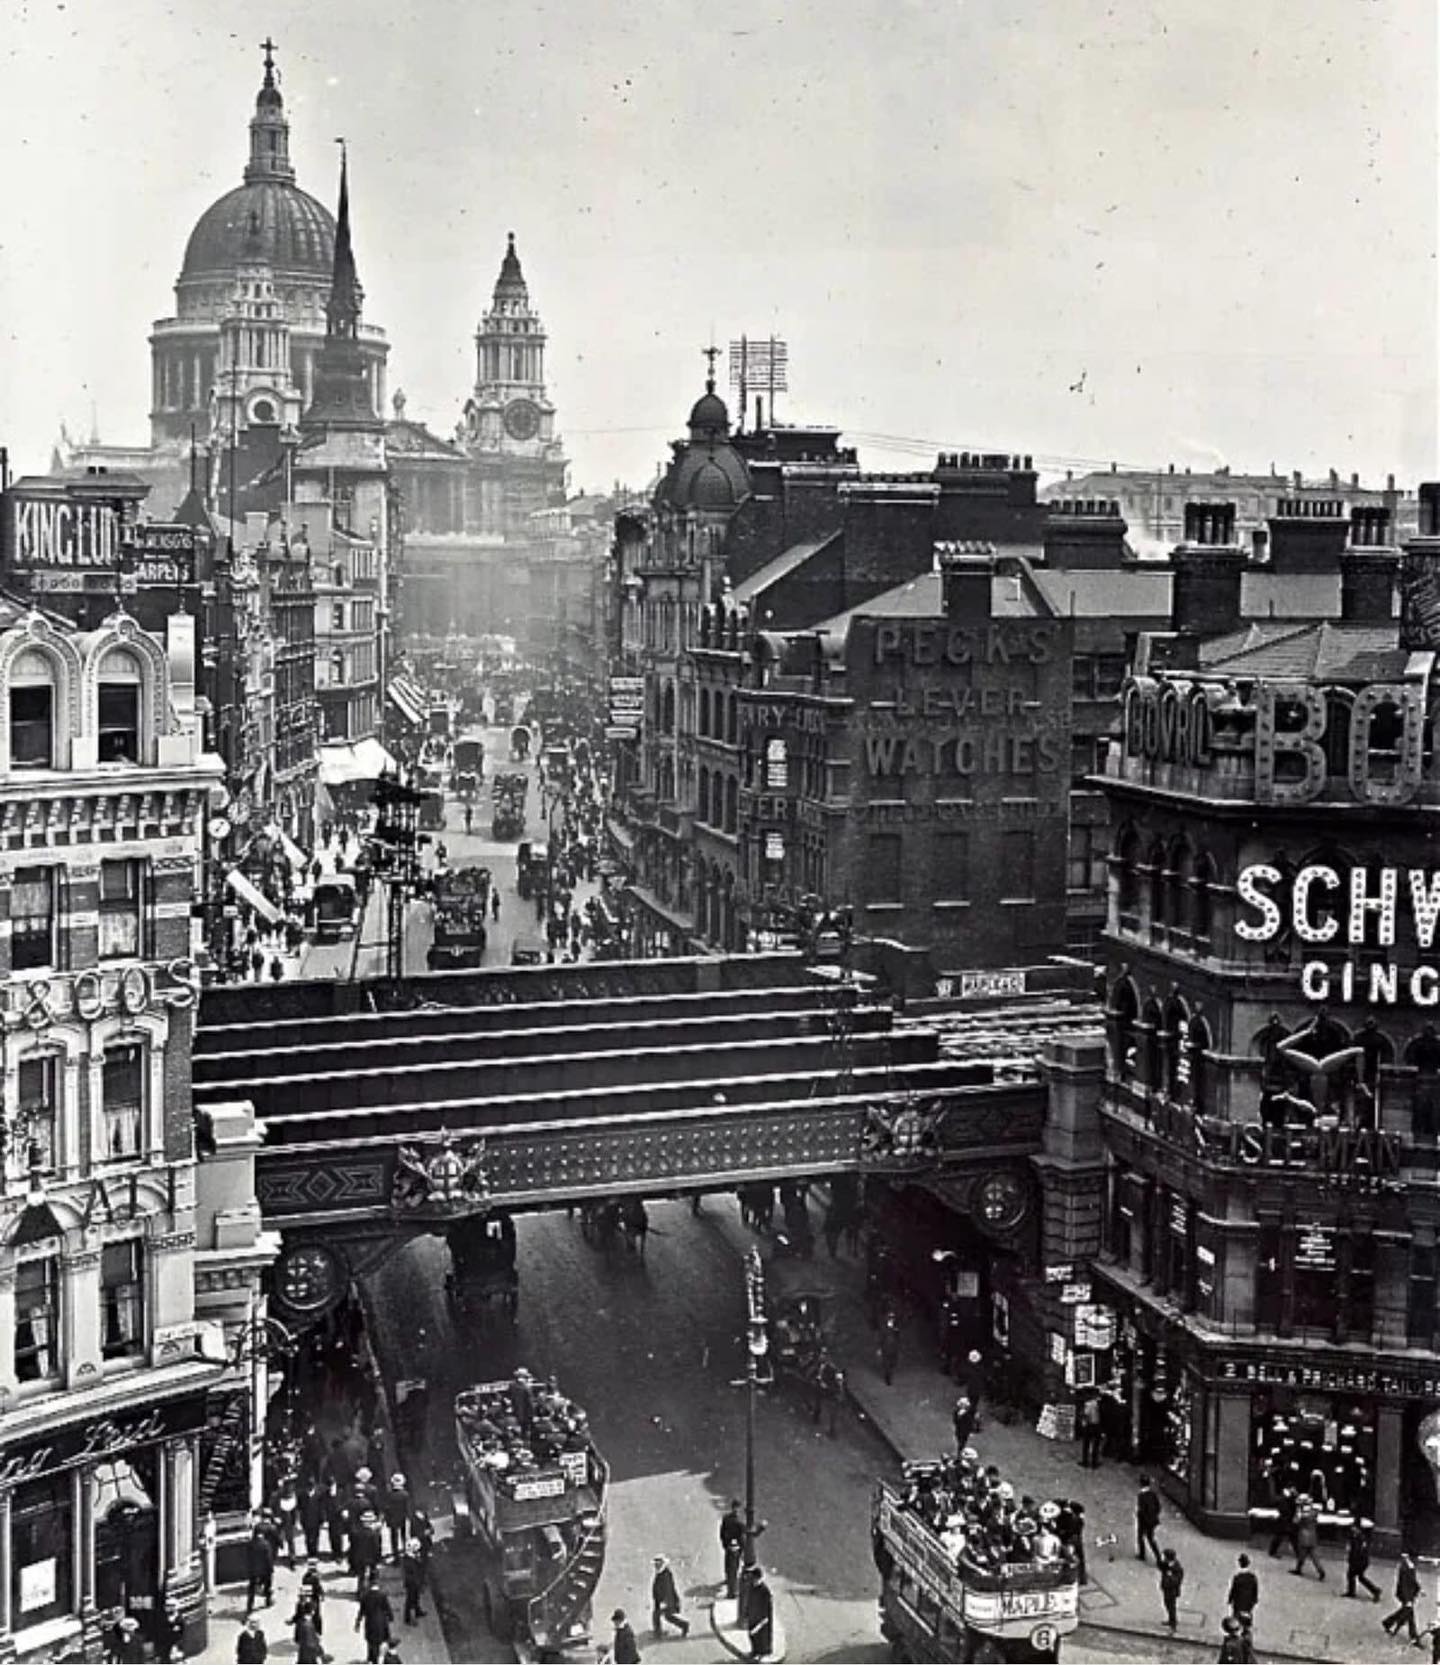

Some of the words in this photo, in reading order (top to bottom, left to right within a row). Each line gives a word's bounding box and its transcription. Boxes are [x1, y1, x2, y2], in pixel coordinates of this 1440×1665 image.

[15, 501, 73, 564] KING
[134, 561, 191, 581] ARPETS
[897, 687, 1026, 716] LEVER
[866, 735, 1060, 776] WATCHES
[1254, 682, 1440, 805] BO
[24, 978, 56, 1029] &
